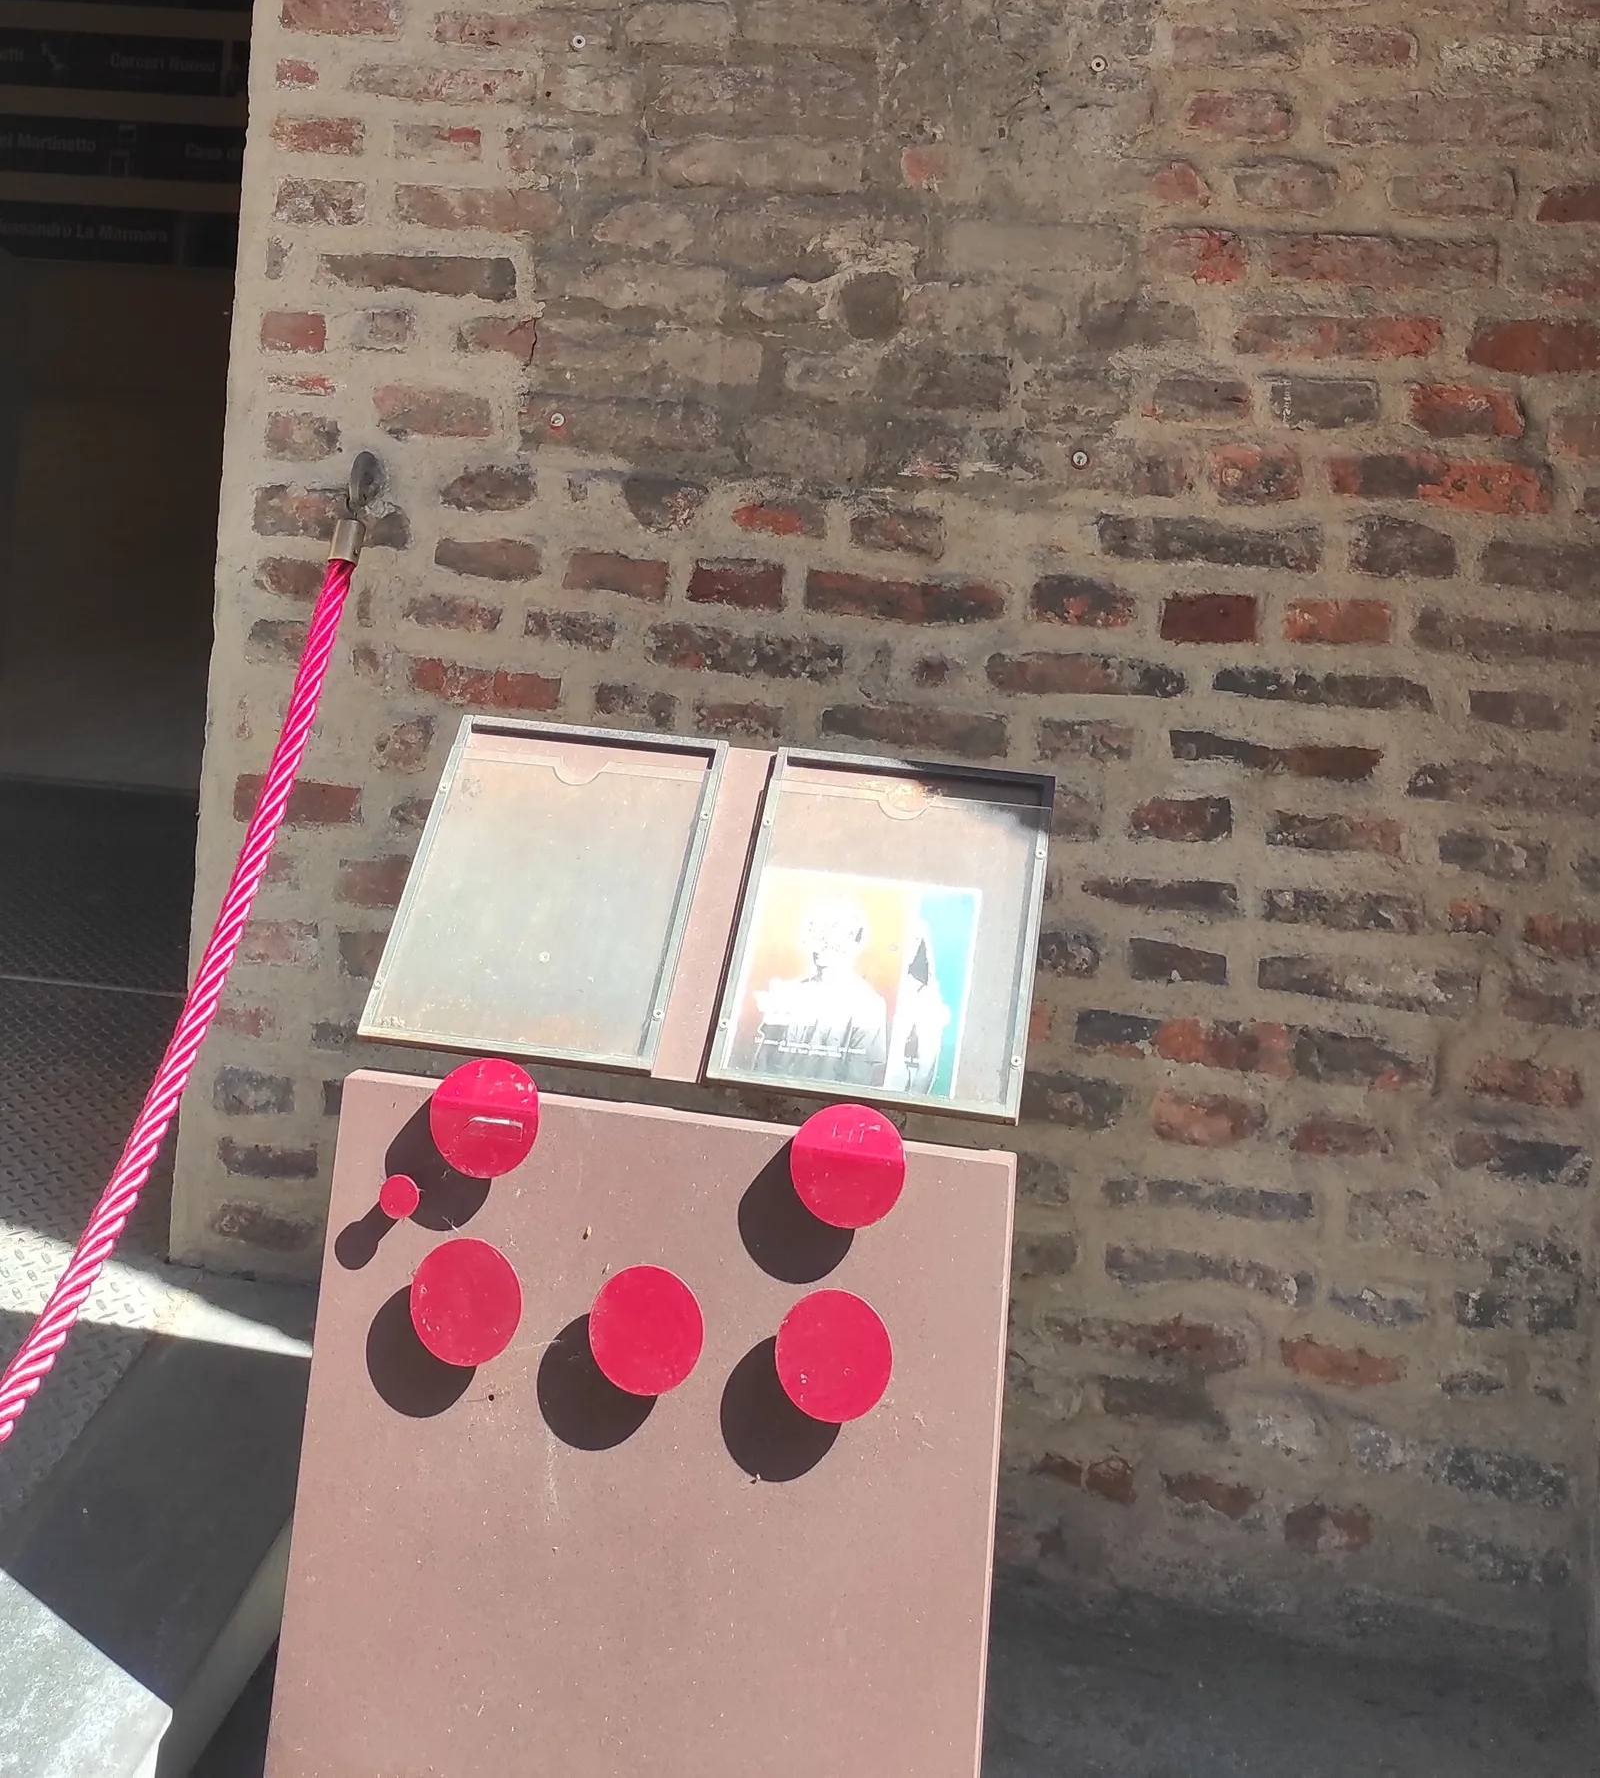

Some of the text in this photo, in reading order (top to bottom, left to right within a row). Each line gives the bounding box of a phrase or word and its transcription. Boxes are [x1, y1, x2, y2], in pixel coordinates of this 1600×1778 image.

[110, 51, 216, 73] Carceri Nuove
[17, 132, 96, 153] Martinetto
[185, 142, 223, 161] Casa
[76, 221, 94, 239] La
[99, 224, 168, 244] Marmora
